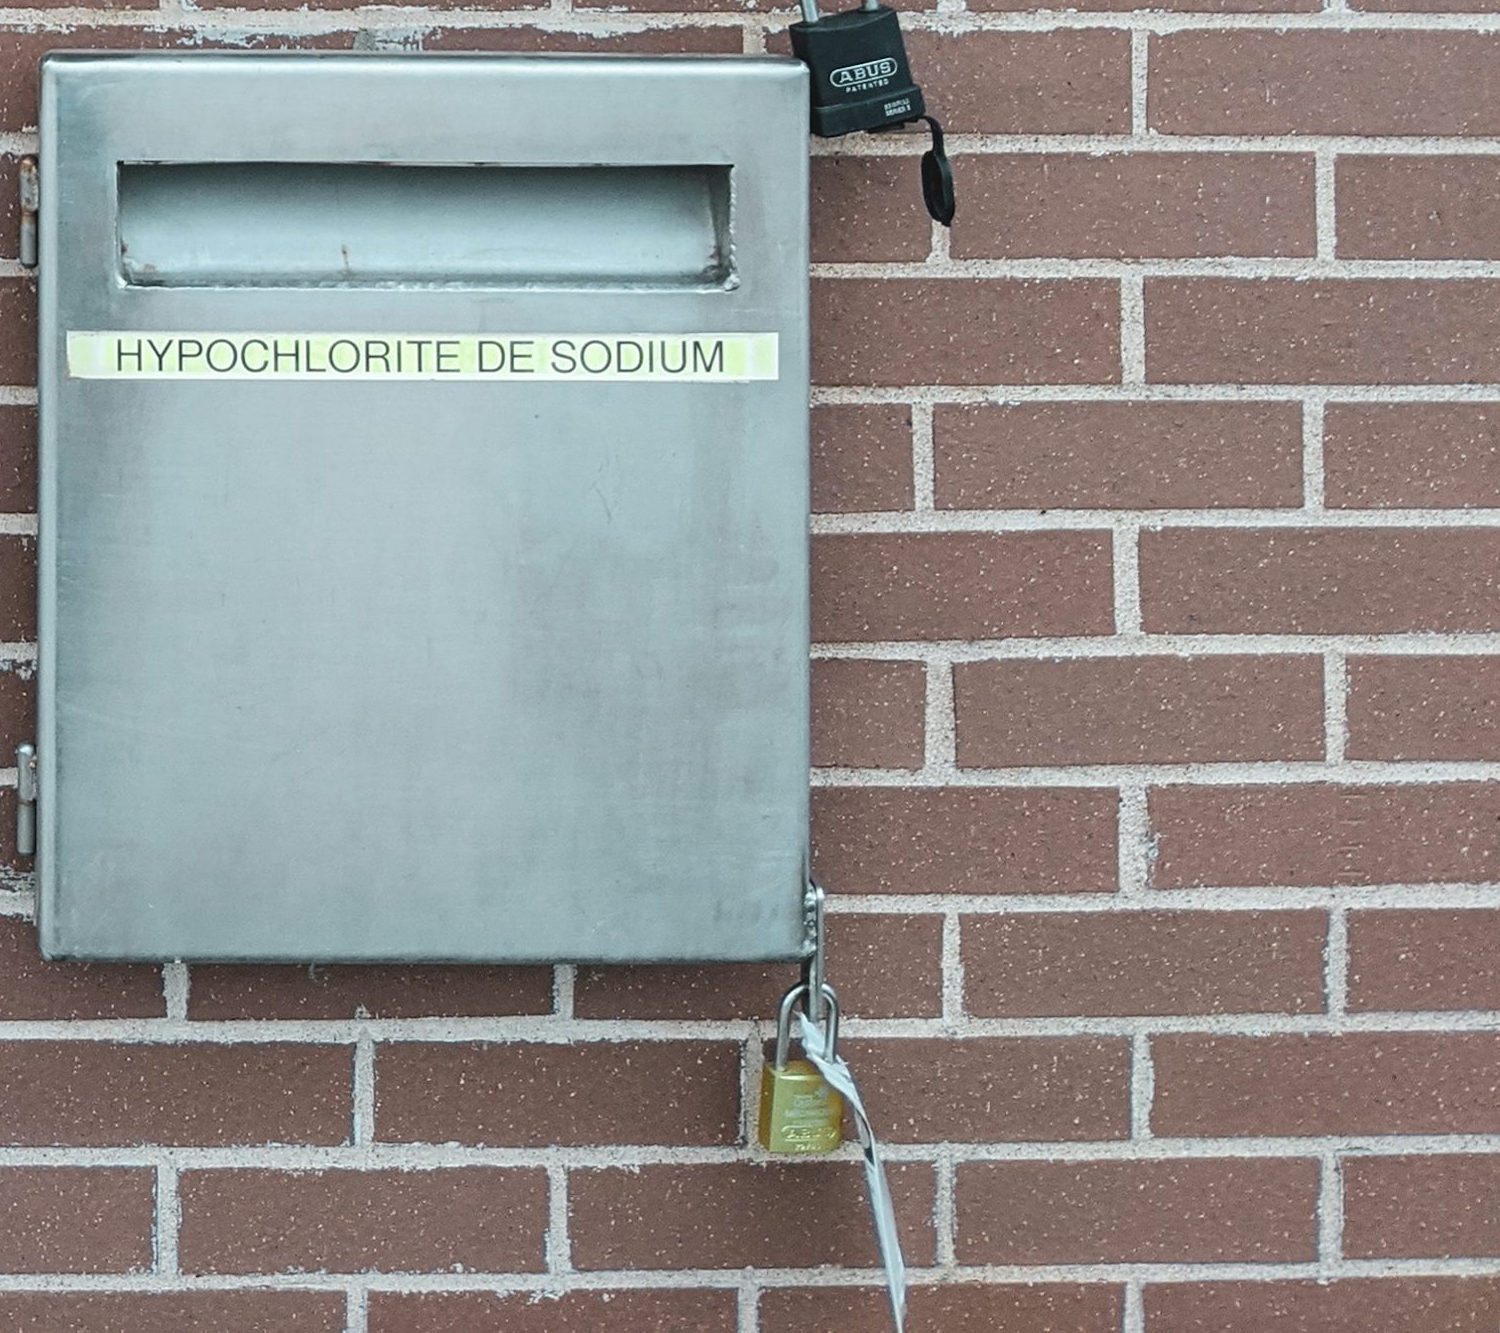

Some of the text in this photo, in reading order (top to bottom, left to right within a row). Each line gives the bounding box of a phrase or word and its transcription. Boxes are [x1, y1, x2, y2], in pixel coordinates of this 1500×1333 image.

[839, 61, 891, 83] ABUS
[116, 338, 724, 375] HYPOCHLORITE DE SODIUM
